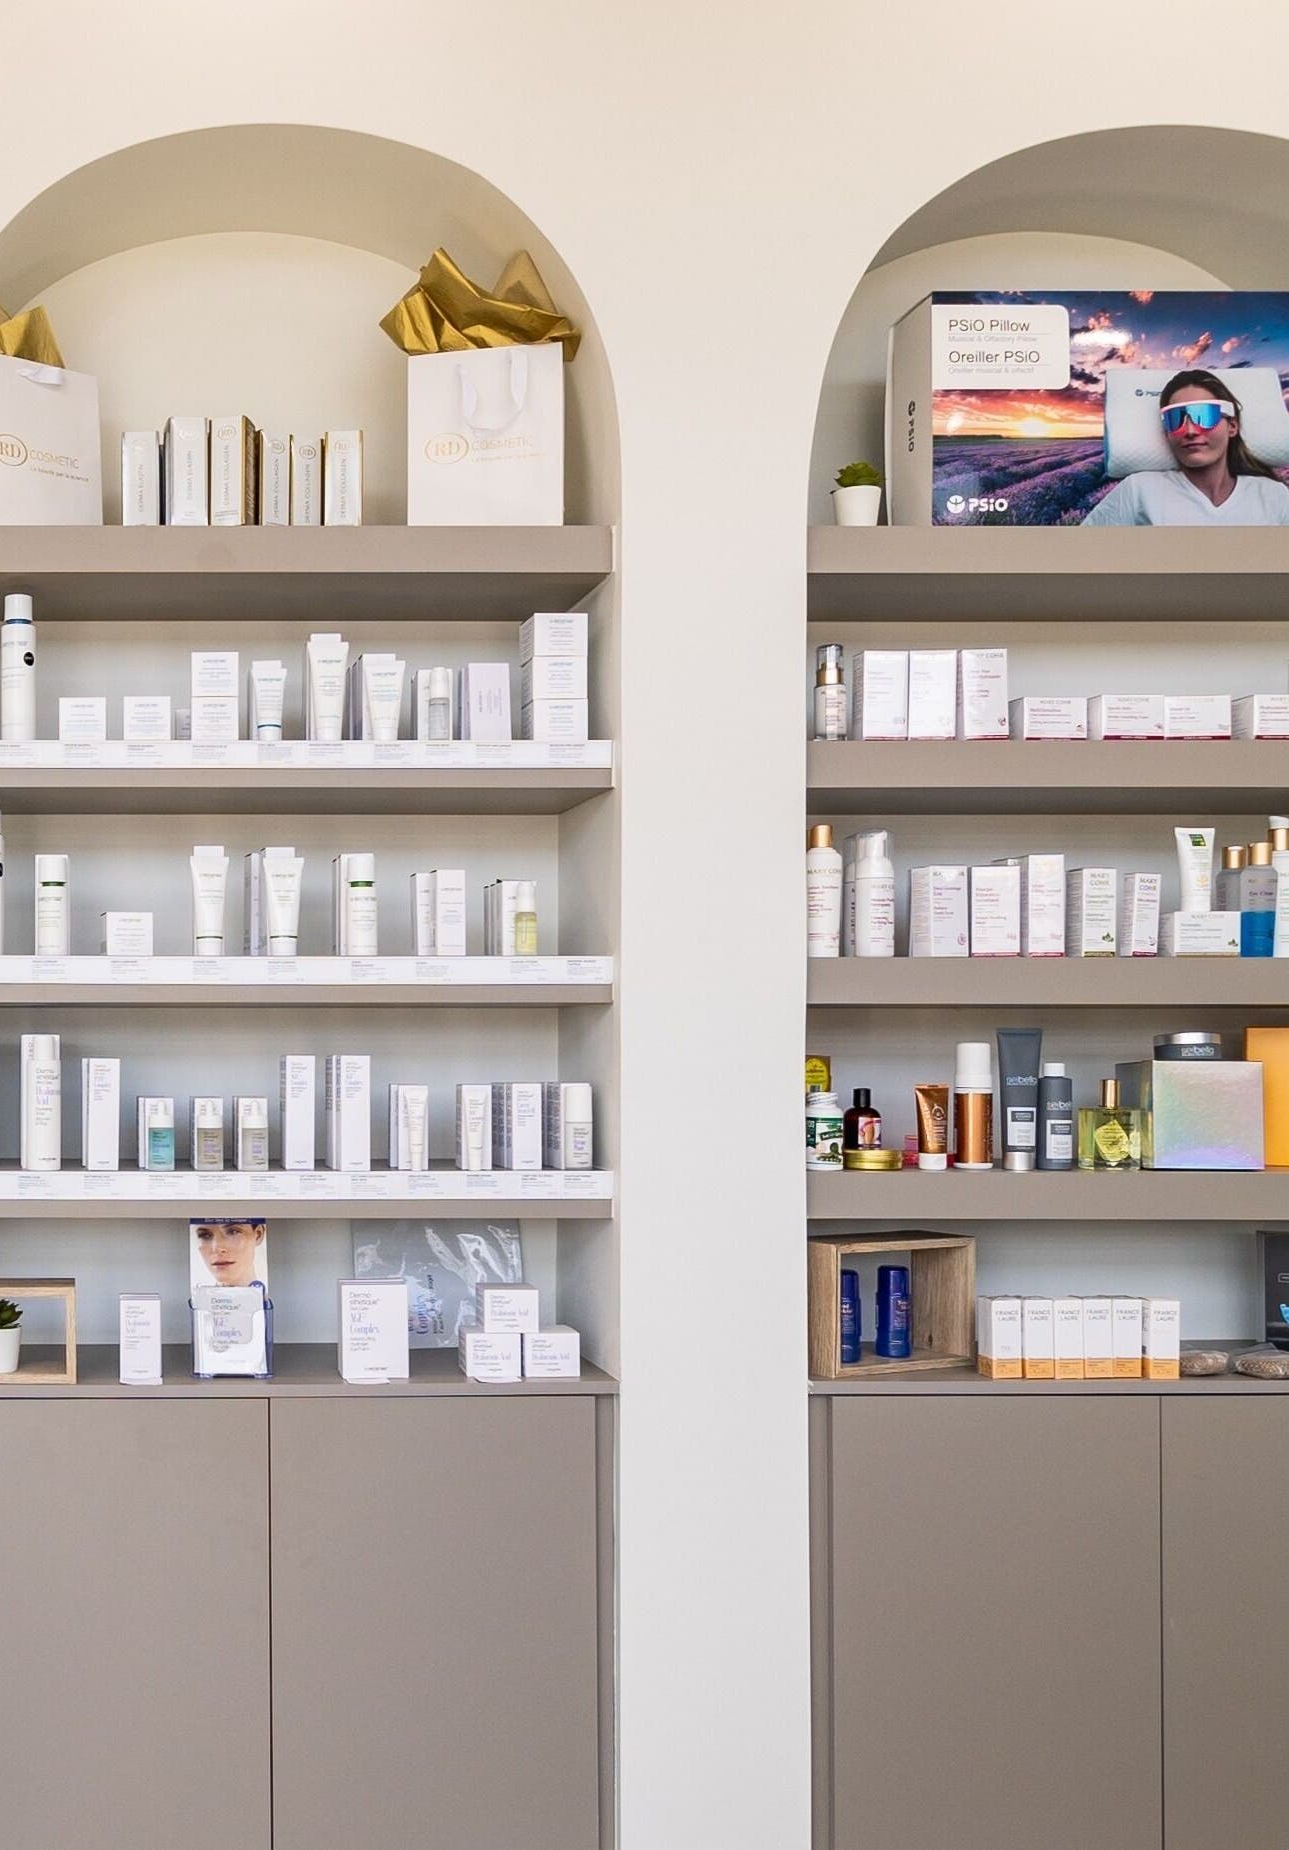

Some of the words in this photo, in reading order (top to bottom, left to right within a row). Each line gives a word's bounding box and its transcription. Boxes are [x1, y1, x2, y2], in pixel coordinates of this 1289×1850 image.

[948, 319, 985, 332] PSiO
[989, 319, 1031, 332] Pillow
[948, 350, 1000, 363] Oreiller
[1003, 350, 1041, 363] PSiO
[29, 449, 80, 470] COSMETIC
[968, 498, 1008, 512] PSiO
